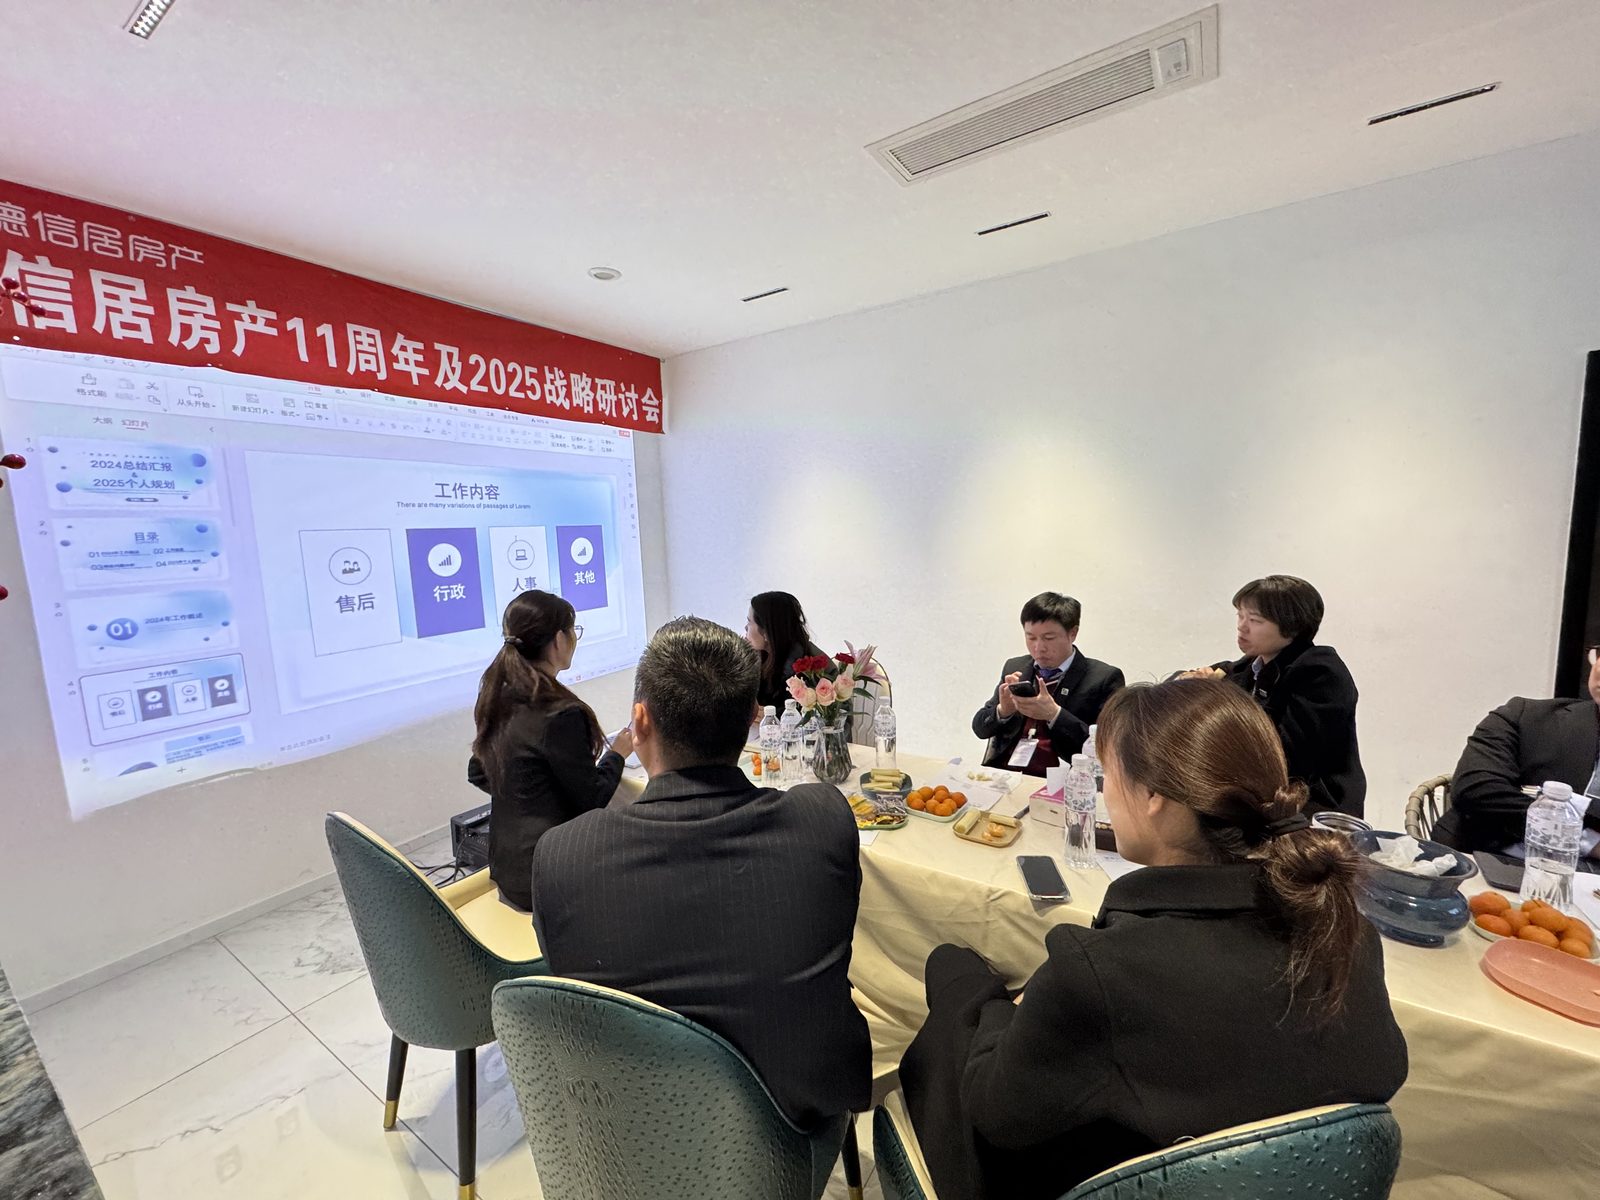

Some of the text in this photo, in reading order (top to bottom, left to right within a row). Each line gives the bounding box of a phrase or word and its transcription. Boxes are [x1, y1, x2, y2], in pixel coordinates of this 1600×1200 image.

[1, 249, 660, 424] 信居房产11周年及2025战略研讨会
[90, 459, 173, 472] 2024总结汇报
[93, 479, 175, 489] 2025个人规划
[434, 482, 500, 500] 工作内容
[134, 532, 159, 541] 目录
[512, 576, 537, 592] 人事
[574, 571, 596, 586] 其他
[433, 584, 467, 602] 行政
[336, 592, 376, 614] 售后
[110, 621, 133, 636] 01
